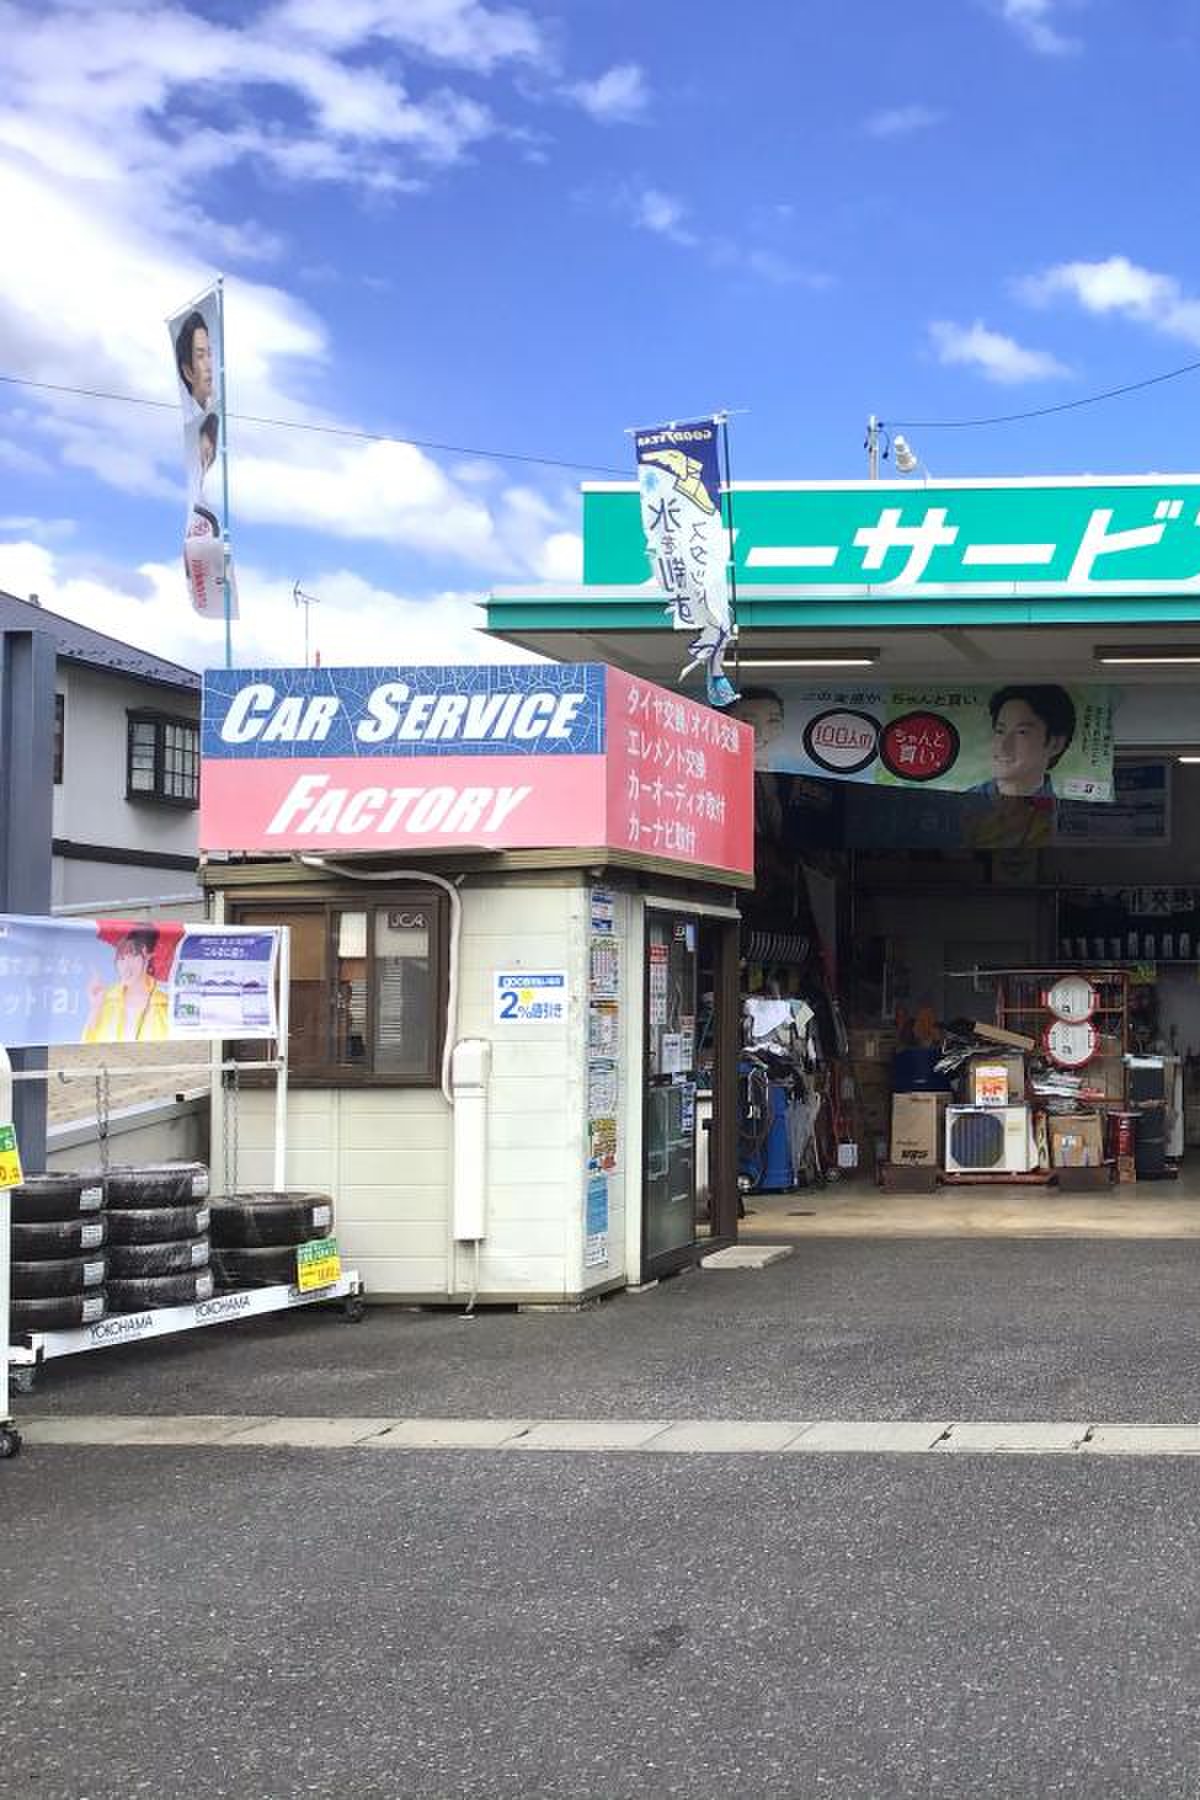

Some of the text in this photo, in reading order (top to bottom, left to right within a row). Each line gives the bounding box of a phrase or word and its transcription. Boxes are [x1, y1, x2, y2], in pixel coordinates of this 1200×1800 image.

[220, 683, 585, 743] CAR SERVICE
[264, 774, 532, 835] FACTORY
